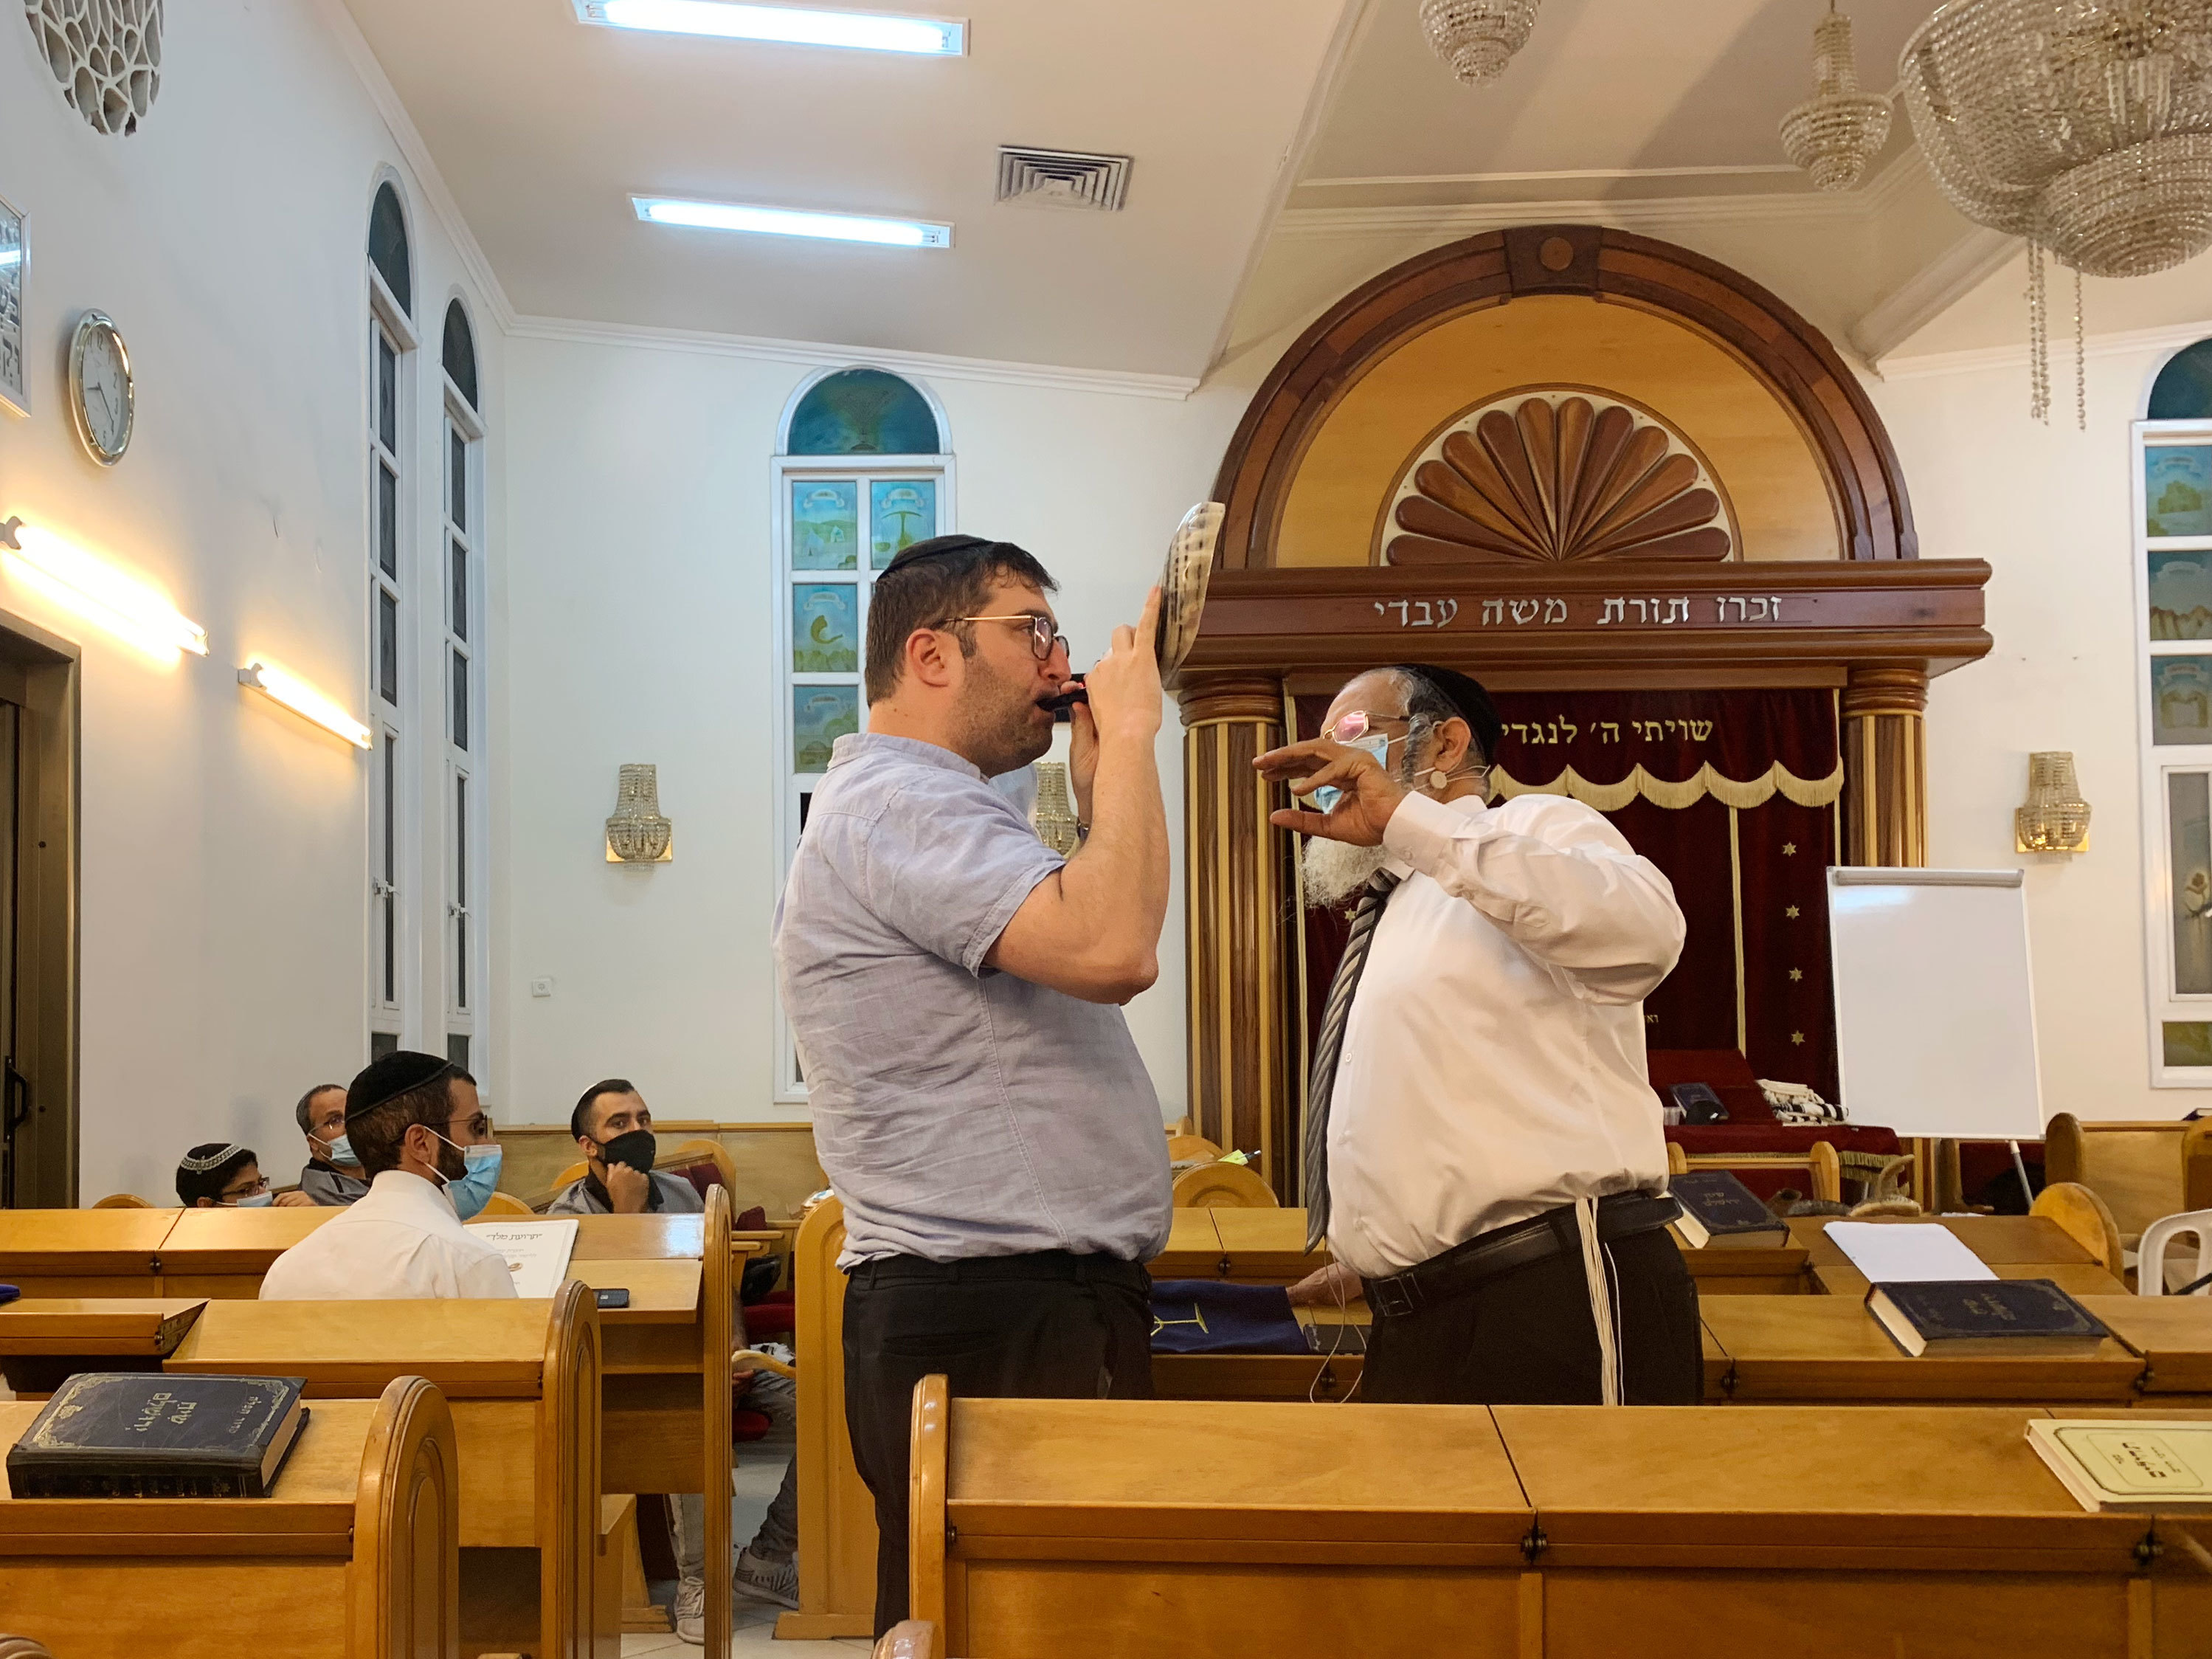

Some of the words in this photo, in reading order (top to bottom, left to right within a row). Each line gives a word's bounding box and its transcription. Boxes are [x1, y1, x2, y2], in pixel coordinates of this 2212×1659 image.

[97, 331, 104, 352] 12
[1374, 598, 1458, 628] עבדי
[1482, 598, 1568, 625] משה
[1597, 596, 1690, 624] תורת
[1715, 596, 1782, 622] זכרו
[1501, 714, 1577, 744] לנגדי
[1631, 719, 1713, 741] שויתי
